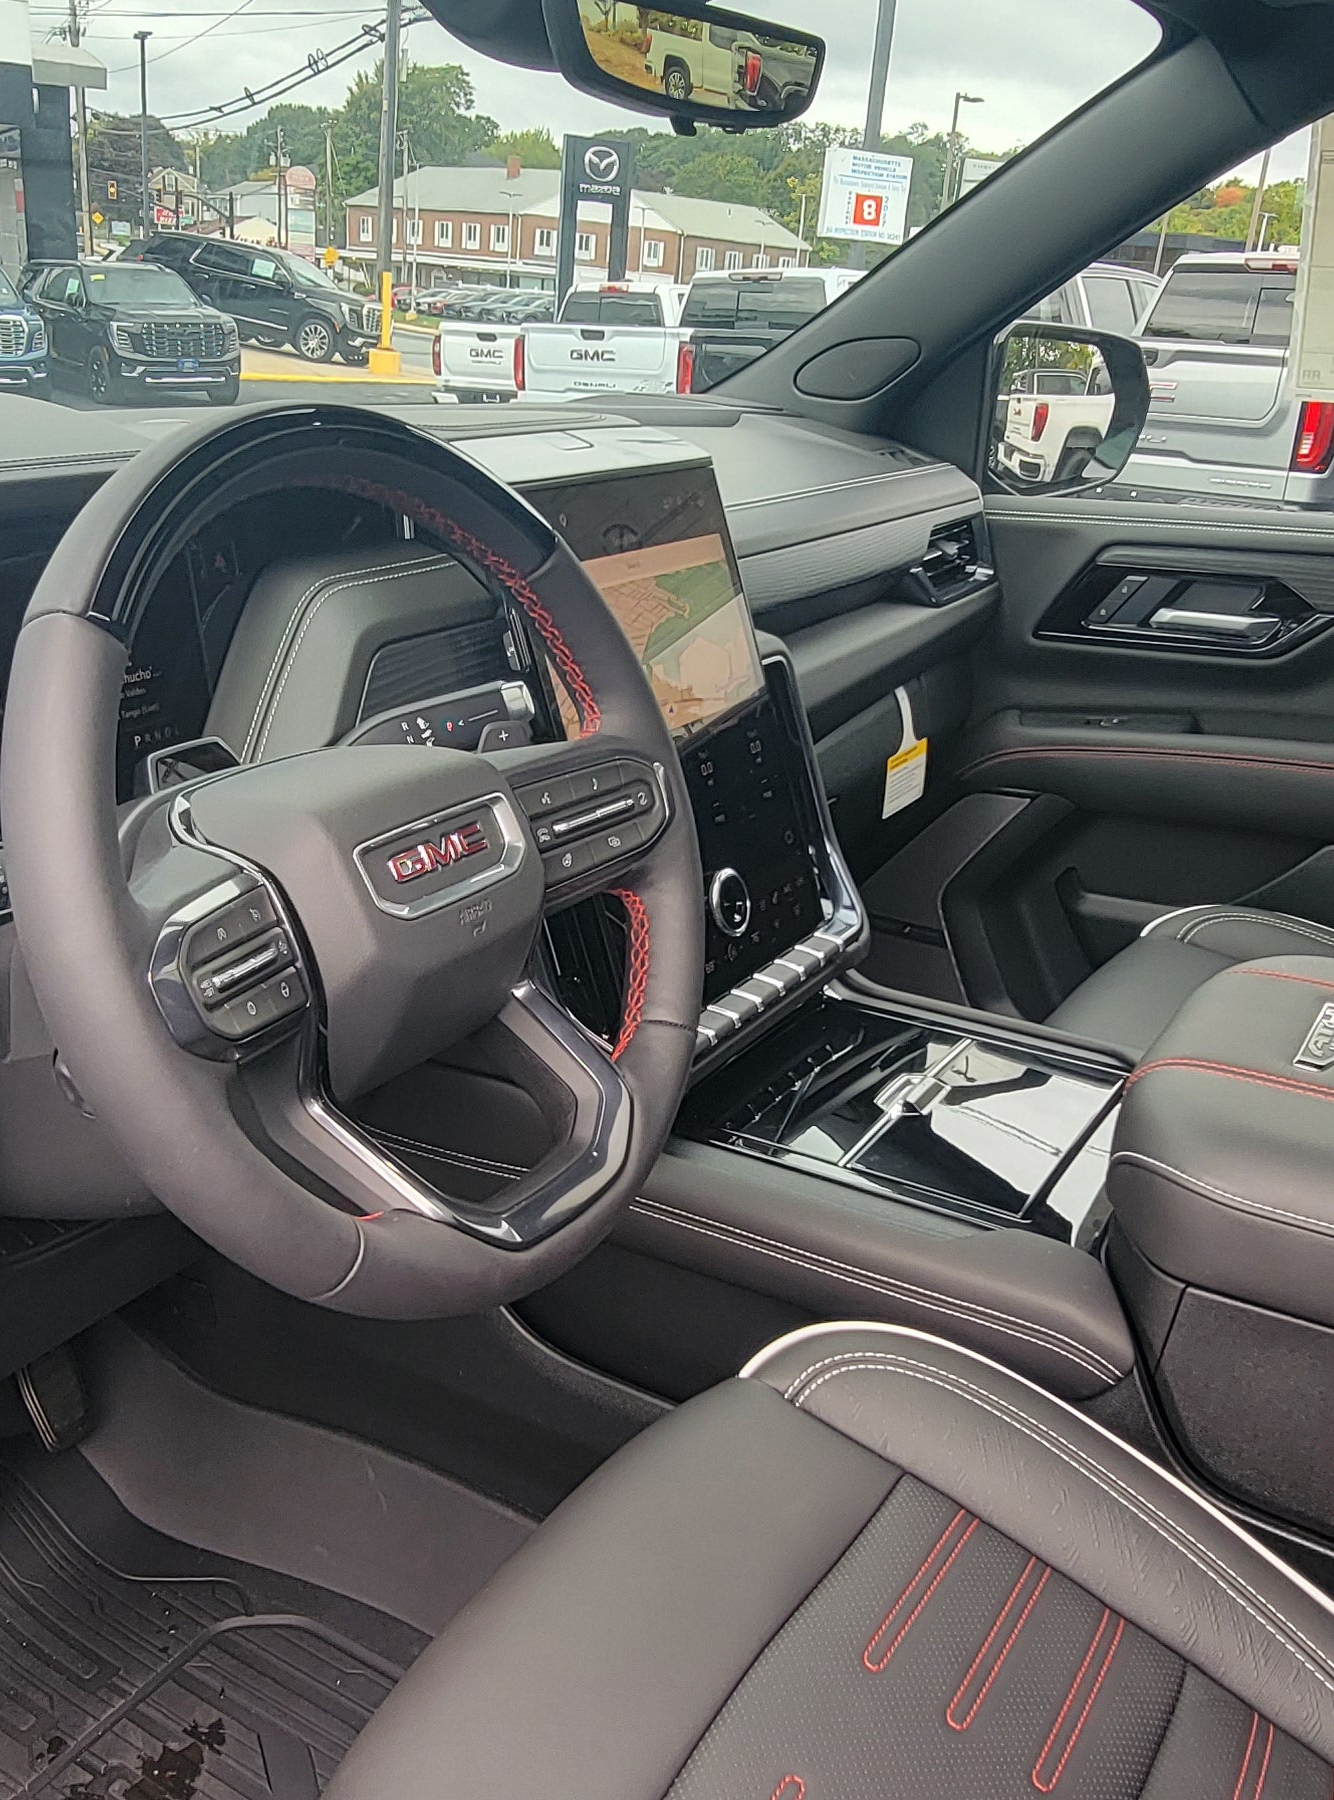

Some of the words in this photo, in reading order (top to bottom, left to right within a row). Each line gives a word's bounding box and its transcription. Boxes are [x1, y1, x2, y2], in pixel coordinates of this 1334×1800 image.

[579, 183, 621, 196] mazda
[862, 199, 877, 220] 8
[469, 348, 504, 359] GMC
[570, 349, 616, 362] GMC
[401, 721, 410, 731] R
[387, 821, 490, 881] GMC
